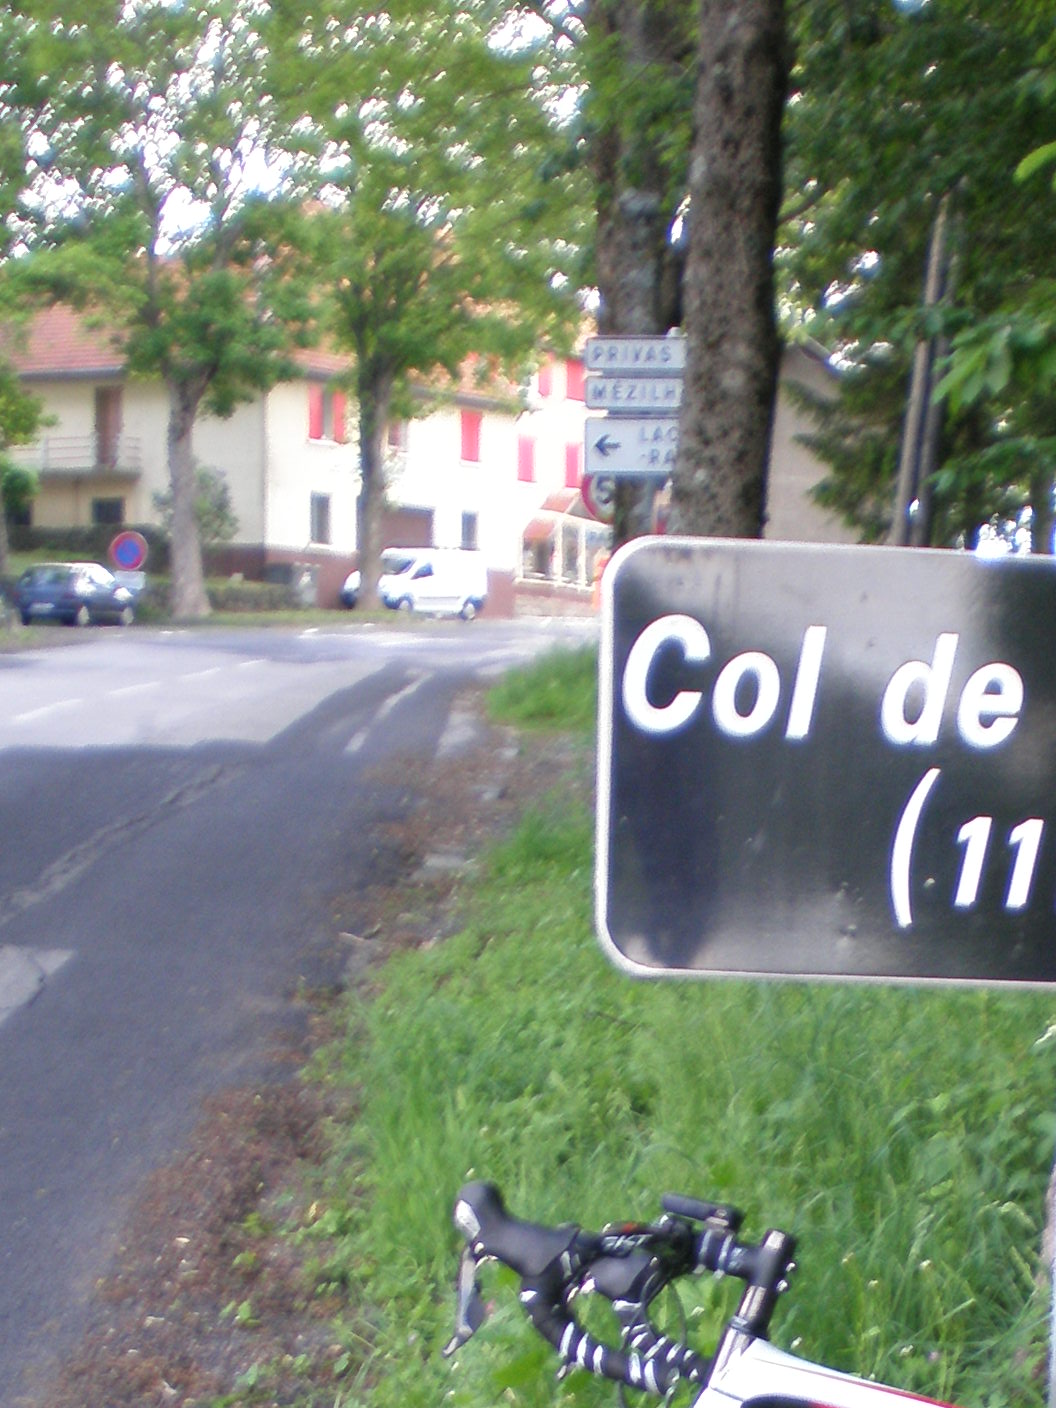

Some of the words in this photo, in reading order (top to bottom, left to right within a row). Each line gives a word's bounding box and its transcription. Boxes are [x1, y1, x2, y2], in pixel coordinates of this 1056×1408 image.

[593, 345, 673, 363] PRIVAS
[622, 613, 828, 739] Col
[879, 632, 1024, 748] de
